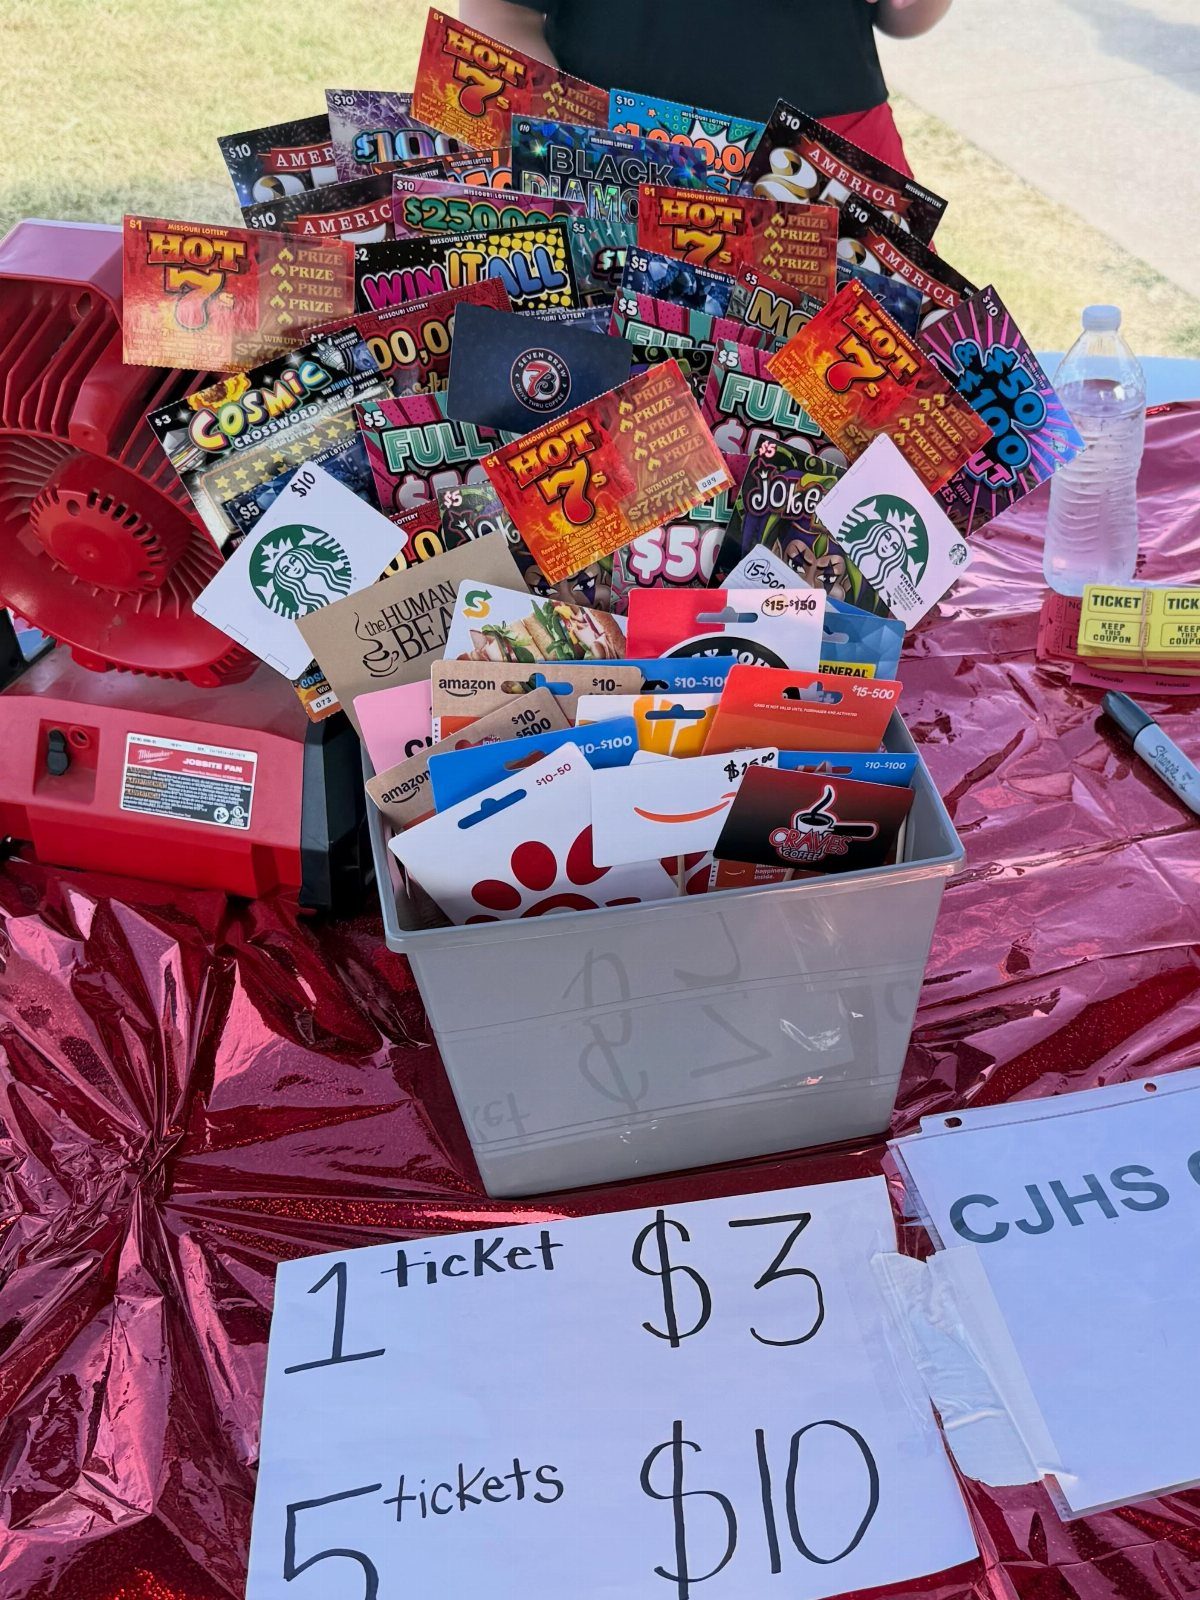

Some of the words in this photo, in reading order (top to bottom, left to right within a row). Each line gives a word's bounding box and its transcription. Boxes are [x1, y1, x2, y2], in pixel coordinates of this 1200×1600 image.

[433, 12, 444, 24] $1
[464, 28, 491, 46] MISSOURI
[443, 27, 527, 86] HOT
[333, 94, 356, 107] $10
[557, 96, 596, 122] PRIZE
[566, 87, 605, 112] PRIZE
[616, 96, 635, 107] $10
[682, 111, 708, 122] MISSOURI
[708, 116, 731, 127] LOTTERY
[779, 111, 800, 131] $10
[229, 144, 251, 159] $10
[550, 144, 674, 187] BLACK
[396, 180, 415, 192] $10
[809, 148, 897, 208] AMERICA
[463, 189, 493, 199] MISSOURI
[494, 193, 519, 202] LOTTERY
[644, 187, 656, 197] $1
[676, 191, 705, 201] MISSOURI
[705, 194, 728, 203] LOTTERY
[251, 212, 276, 229] $10
[302, 204, 393, 235] AMERIC
[659, 197, 745, 234] HOT
[787, 214, 830, 230] PRIZE
[848, 203, 869, 224] $10
[129, 219, 142, 231] $1
[167, 223, 200, 234] MISSOURI
[201, 226, 230, 237] LOTTERY
[572, 222, 586, 234] $5
[429, 236, 460, 246] MISSOURI
[460, 233, 488, 242] LOTTERY
[779, 228, 821, 243] PRIZE
[147, 230, 247, 272] HOT
[299, 250, 344, 266] PRIZE
[787, 243, 828, 258] PRIZE
[288, 265, 335, 281] PRIZE
[631, 255, 648, 272] $5
[778, 258, 820, 271] PRIZE
[362, 265, 446, 309] WIN
[448, 249, 486, 289] IT
[487, 244, 571, 299] ALL
[695, 268, 725, 282] MISSOURI
[744, 272, 759, 286] $5
[786, 273, 827, 287] PRIZE
[874, 241, 956, 307] AMERICA
[297, 282, 343, 299] PRIZE
[852, 284, 864, 297] $1
[288, 299, 334, 314] PRIZE
[378, 307, 406, 321] MISSOURI
[406, 302, 429, 314] LOTTERY
[618, 297, 638, 317] $5
[982, 294, 999, 317] $10
[558, 312, 586, 321] LOTTERY
[878, 308, 899, 335] MISSOURI
[897, 331, 917, 352] LOTTERY
[842, 302, 921, 382] HOT
[518, 352, 544, 368] SEVEN
[547, 355, 567, 378] BREW
[717, 349, 739, 367] $5
[633, 377, 675, 405] PRIZE
[528, 399, 544, 409] THRU
[633, 395, 675, 424] PRIZE
[154, 414, 172, 428] $3
[234, 404, 319, 449] CROSSWORD
[363, 410, 387, 427] $5
[649, 406, 690, 434] PRIZE
[931, 408, 963, 445] PRIZE
[945, 405, 979, 441] PRIZE
[518, 430, 547, 450] MISSOURI
[546, 419, 570, 438] LOTTERY
[648, 424, 690, 453] PRIZE
[923, 425, 957, 461] PRIZE
[330, 438, 357, 457] LOTTERY
[382, 420, 494, 473] FULL
[505, 418, 600, 490] HOT
[663, 436, 705, 463] PRIZE
[758, 442, 778, 459] $5
[910, 430, 942, 466] PRIZE
[486, 455, 500, 469] $1
[904, 445, 938, 481] PRIZE
[290, 471, 317, 498] $10
[645, 479, 663, 494] WIN
[662, 474, 674, 487] UP
[674, 469, 686, 481] TO
[700, 476, 717, 489] 089
[443, 489, 463, 509] $5
[240, 501, 260, 520] $5
[365, 614, 387, 636] the
[380, 580, 459, 629] HUMAN
[1092, 594, 1142, 609] TICKET
[1101, 621, 1126, 631] KEEP
[1093, 634, 1132, 644] COUPON
[438, 677, 496, 691] amazon
[852, 684, 895, 700] $15-500
[315, 696, 332, 709] 073
[182, 758, 222, 770] JOBSITE
[224, 764, 243, 774] FAN
[1148, 745, 1179, 782] Sharpie
[535, 762, 572, 787] $10-50
[381, 769, 430, 804] amazon
[769, 827, 854, 856] CRAVES
[783, 848, 820, 861] COFFEE
[949, 1164, 1170, 1244] CJHS
[284, 1261, 386, 1374] 1
[284, 1482, 382, 1600] 5
[383, 1458, 565, 1521] tickets
